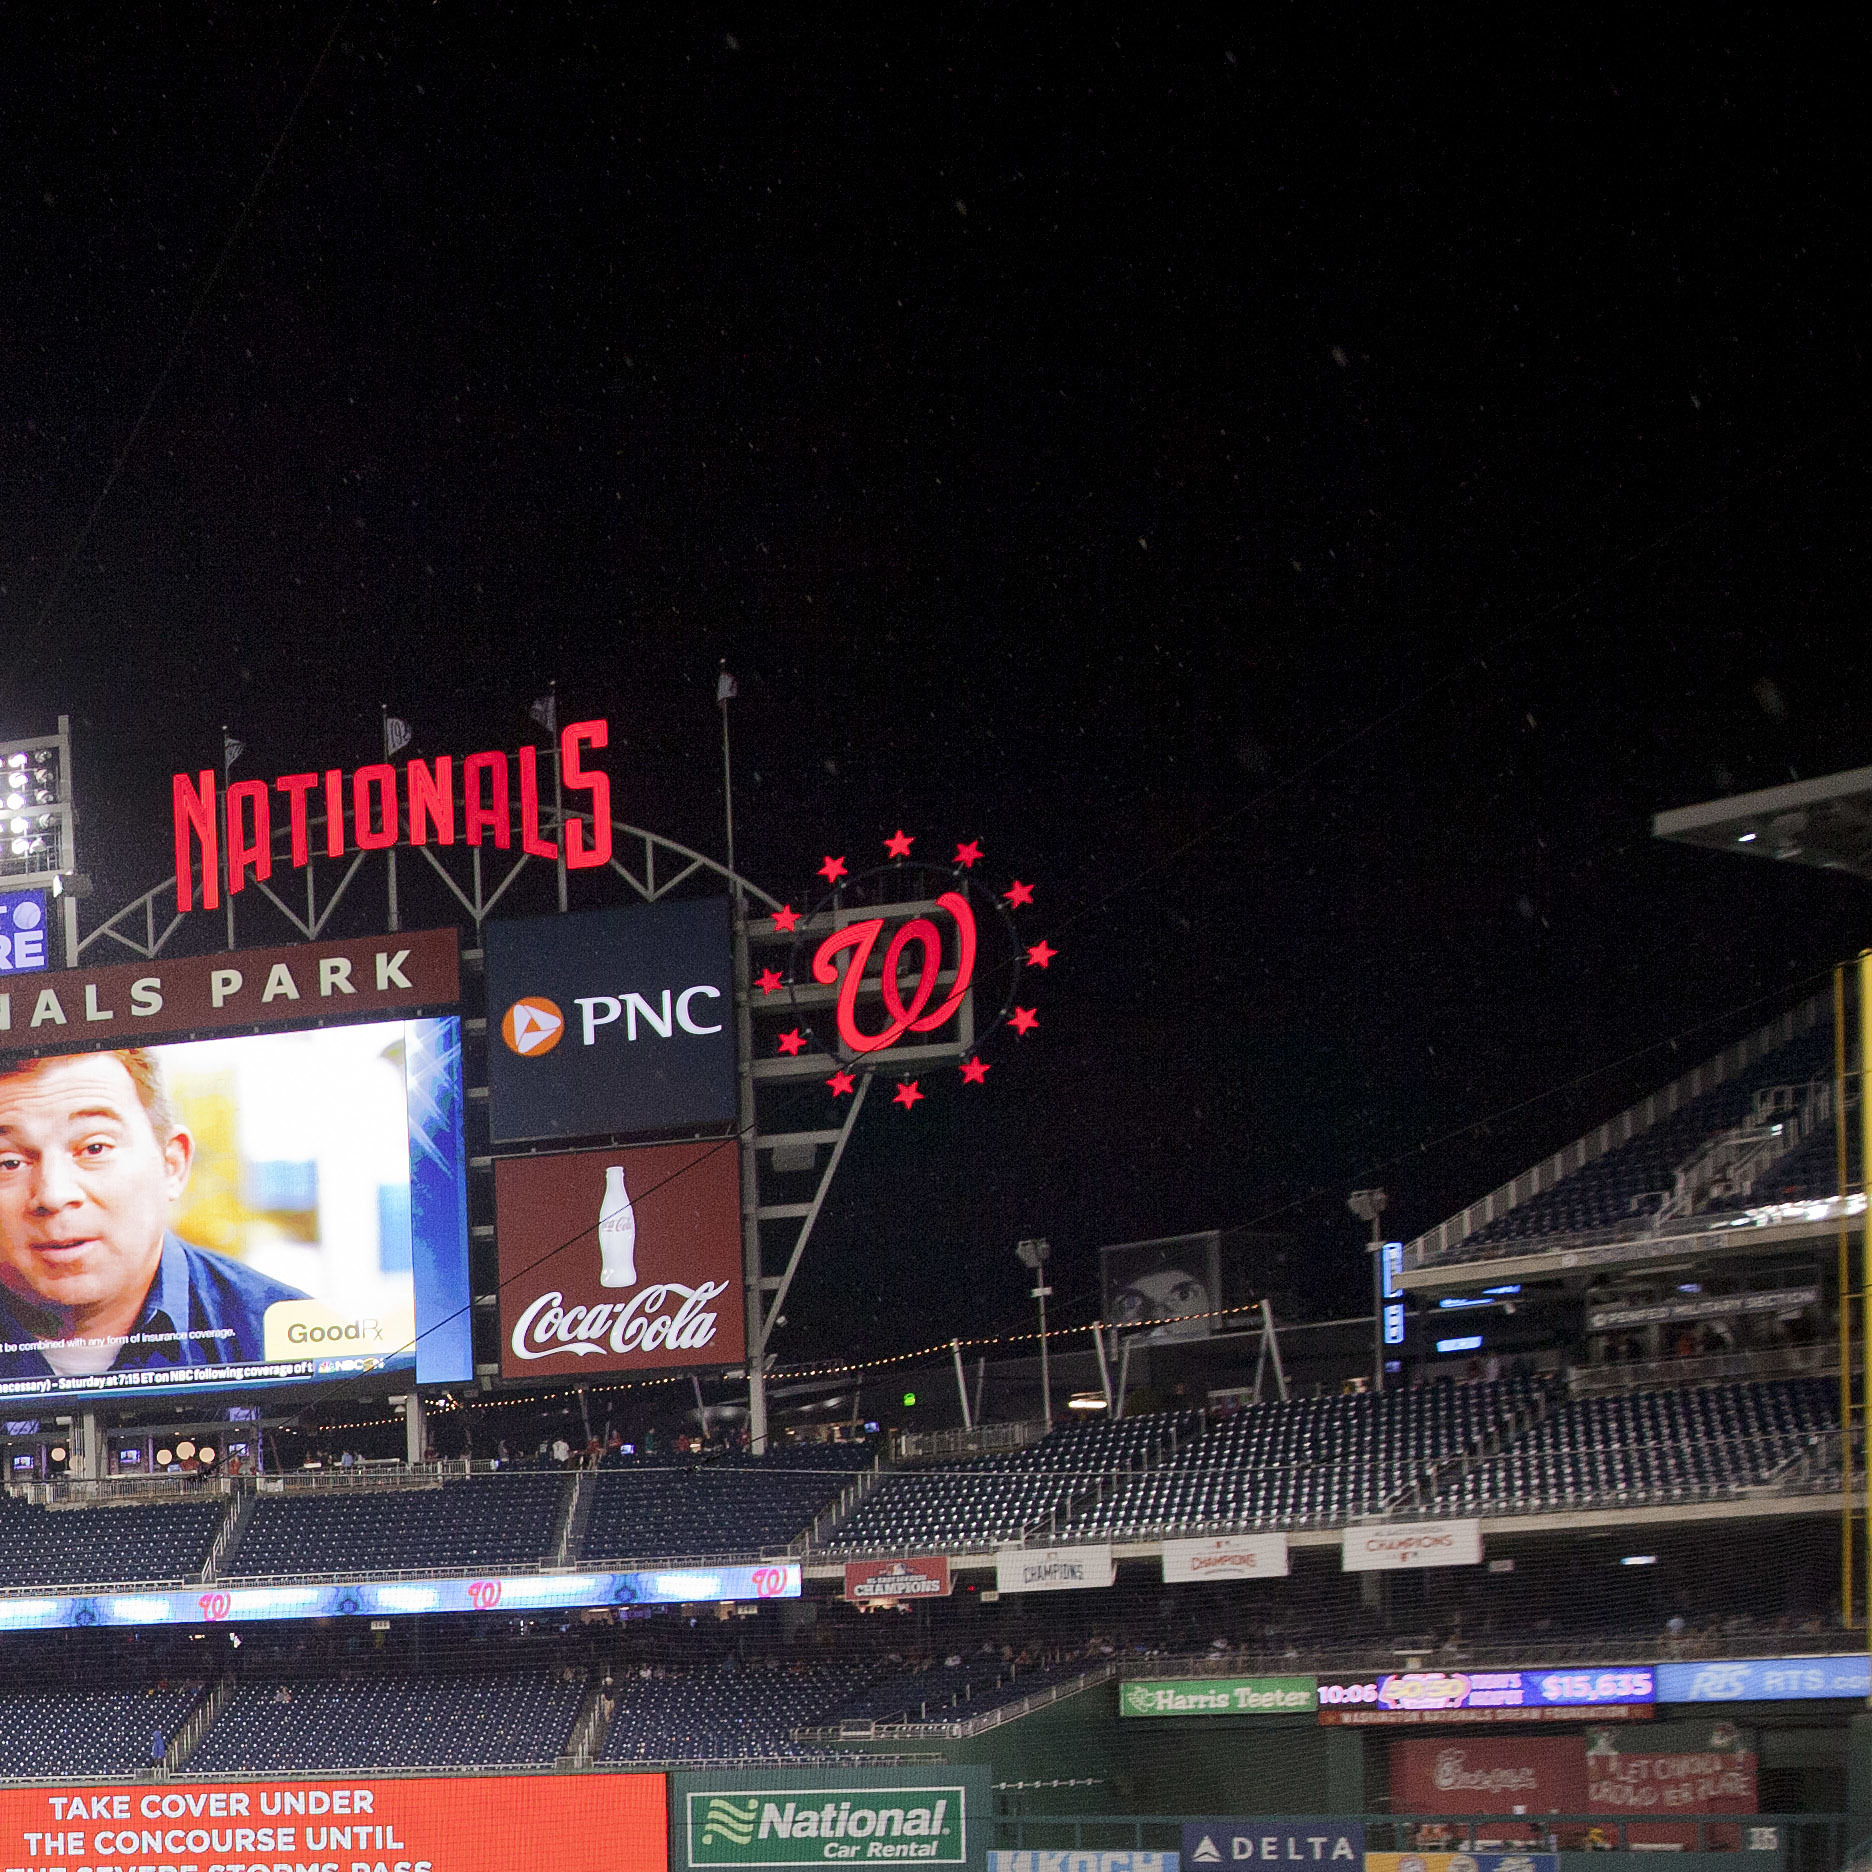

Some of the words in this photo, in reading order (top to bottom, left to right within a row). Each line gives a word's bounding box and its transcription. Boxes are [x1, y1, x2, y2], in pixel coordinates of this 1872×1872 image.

[172, 719, 613, 913] NATIONALS
[212, 949, 414, 1008] PARK
[811, 891, 977, 1051] W
[574, 985, 723, 1047] PNC
[512, 1280, 729, 1361] Coca-Cola
[19, 1338, 64, 1352] combined
[66, 1336, 86, 1348] with
[107, 1333, 129, 1345] form
[142, 1331, 187, 1344] insurance
[59, 1375, 106, 1391] Saturday
[118, 1373, 140, 1386] 7:15
[170, 1369, 193, 1383] NBC
[194, 1364, 243, 1381] following
[243, 1364, 293, 1379] coverage
[854, 1579, 940, 1597] CHAMPIONS
[1155, 1685, 1226, 1711] Harris
[1232, 1684, 1310, 1709] Teeter
[1541, 1672, 1653, 1701] $15,635
[49, 1794, 131, 1821] TAKE
[140, 1792, 250, 1819] COVER
[260, 1789, 374, 1816] UNDER
[24, 1831, 85, 1856] THE
[93, 1827, 296, 1856] CONCOURSE
[306, 1823, 405, 1851] UNTIL
[822, 1841, 861, 1859] Car
[866, 1839, 938, 1858] Rental
[1231, 1836, 1356, 1863] DELTA
